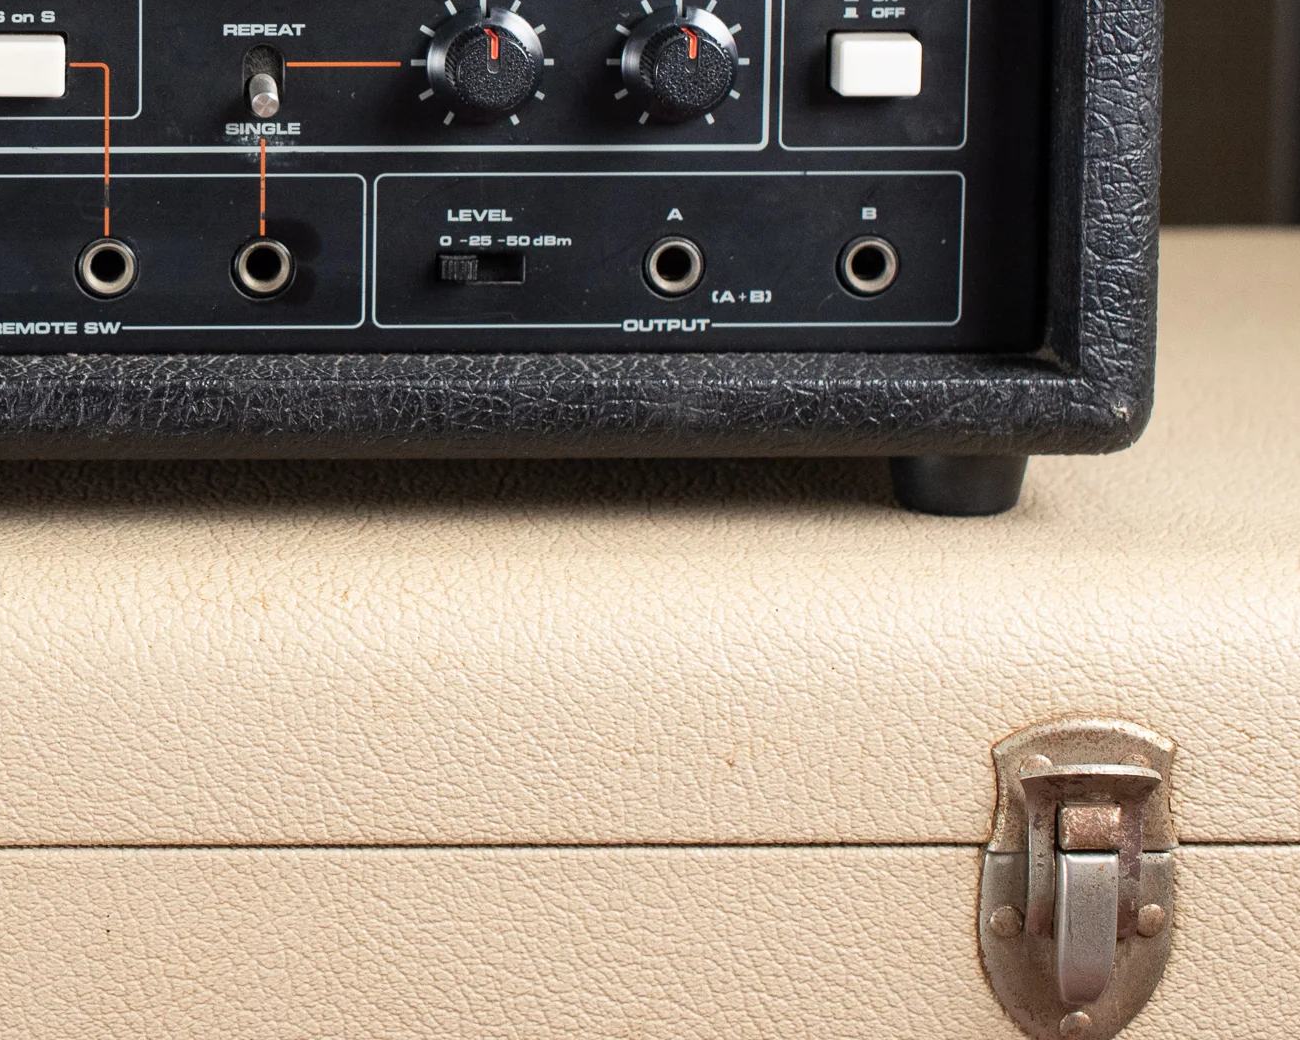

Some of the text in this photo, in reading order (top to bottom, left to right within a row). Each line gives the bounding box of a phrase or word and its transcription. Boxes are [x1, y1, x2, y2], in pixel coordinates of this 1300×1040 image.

[11, 14, 34, 23] on
[41, 11, 55, 23] S
[871, 7, 905, 18] OFF
[223, 24, 305, 36] REPEAT
[225, 123, 300, 135] SINGLE
[447, 209, 512, 221] LEVEL
[667, 208, 683, 221] A
[862, 207, 877, 220] B
[439, 235, 452, 246] 0
[84, 322, 121, 334] SW
[622, 320, 710, 332] OUTPUT
